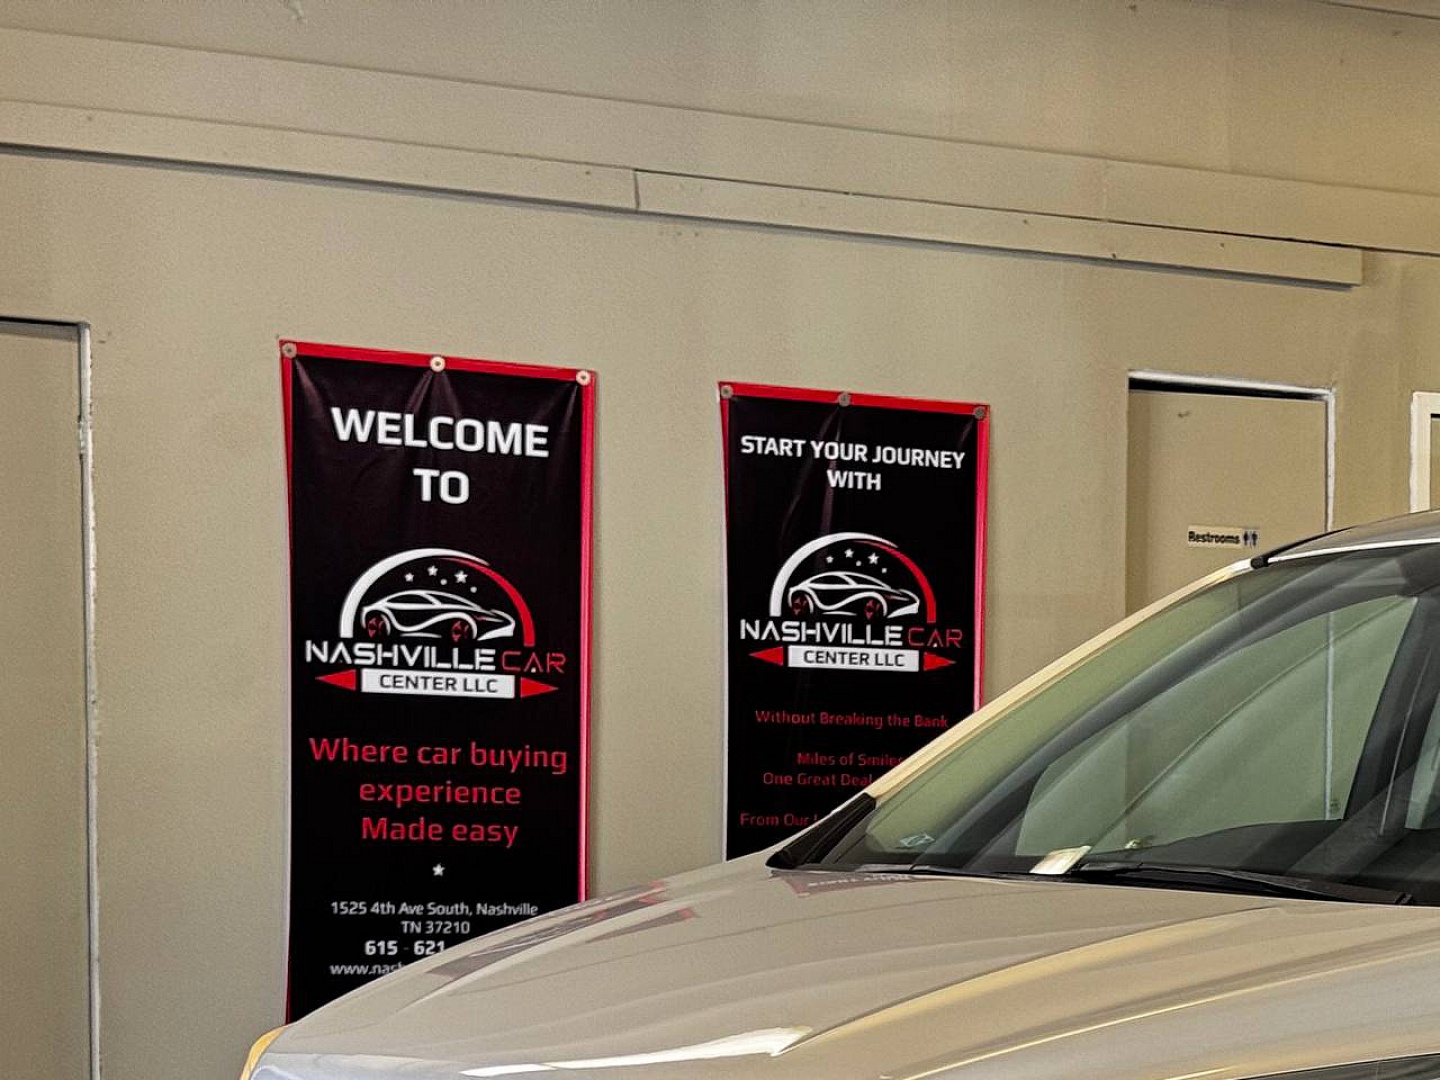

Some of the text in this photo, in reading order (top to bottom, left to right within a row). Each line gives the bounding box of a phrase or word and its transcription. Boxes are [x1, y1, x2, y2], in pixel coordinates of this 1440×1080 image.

[330, 406, 549, 458] WELCOME
[740, 434, 965, 470] START YOUR JOURNEY
[412, 468, 470, 504] TO
[826, 469, 882, 491] WITH
[1188, 530, 1240, 544] Restrooms
[740, 619, 963, 648] NASHVILLE CAR
[305, 639, 566, 674] NASHVILLE CAR
[803, 649, 905, 668] CENTER LLC
[379, 674, 499, 694] CENTER LLC
[755, 710, 949, 729] Without Breaking the Bank
[308, 737, 568, 775] Where car buying
[797, 752, 836, 766] Miles
[839, 752, 854, 766] of
[763, 772, 793, 786] One
[797, 772, 836, 786] Great
[358, 781, 522, 808] experience
[740, 812, 780, 826] From
[783, 813, 810, 826] Our
[361, 816, 519, 848] Made easy
[330, 901, 538, 918] 1525 4th Ave South, Nashville
[400, 920, 470, 935] TN 37210
[364, 940, 399, 956] 615
[413, 940, 446, 956] 621
